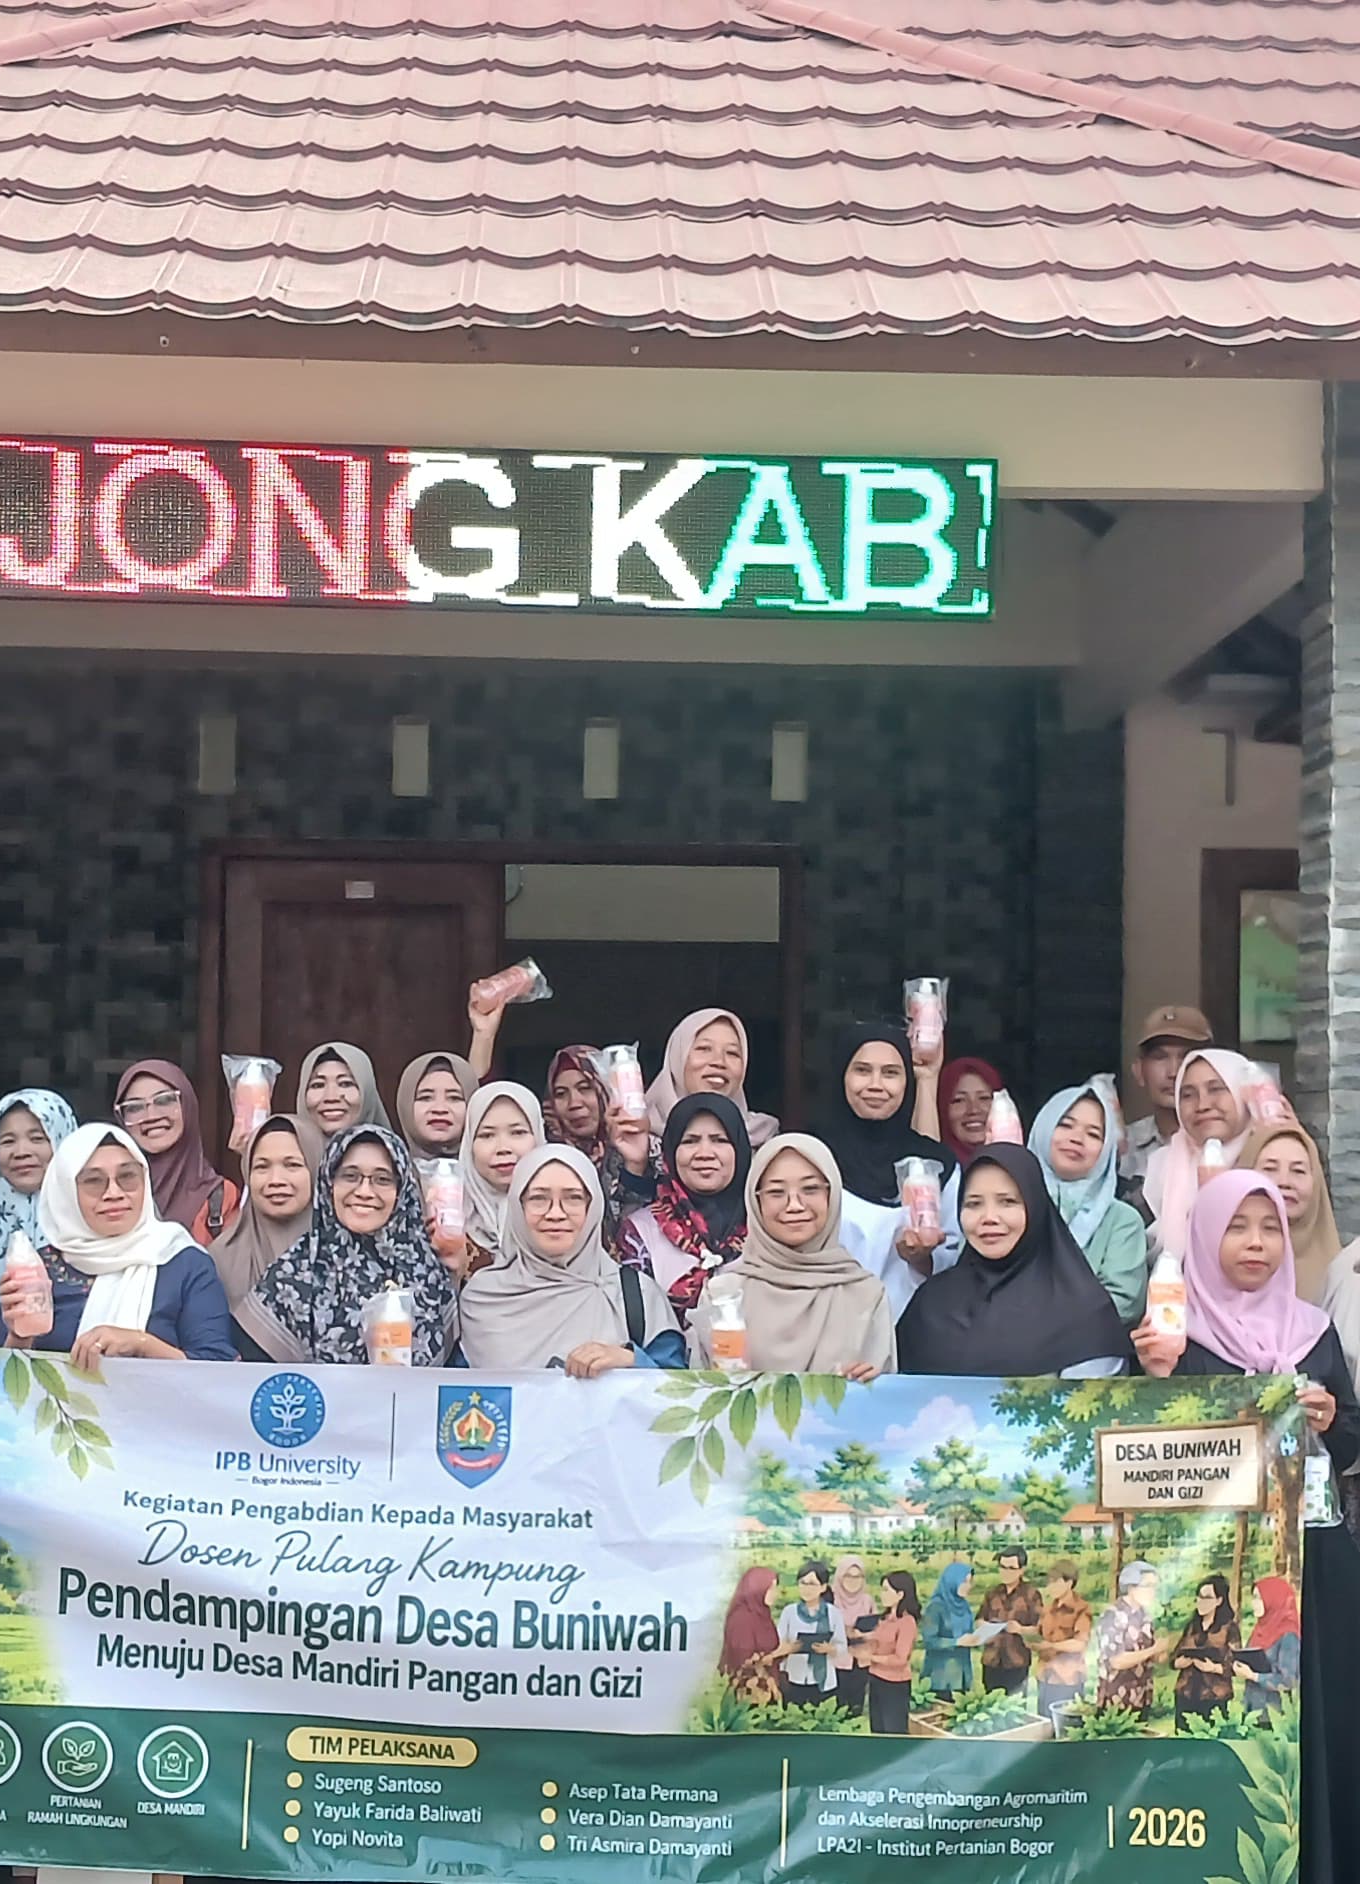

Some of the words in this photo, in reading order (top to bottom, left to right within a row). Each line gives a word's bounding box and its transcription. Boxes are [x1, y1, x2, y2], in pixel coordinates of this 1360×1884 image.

[589, 457, 959, 610] KAB
[1115, 1444, 1157, 1461] DESA
[1163, 1438, 1241, 1460] BUNIWAH
[215, 1451, 251, 1471] IPB
[258, 1453, 361, 1480] University
[1123, 1469, 1174, 1483] MANDIRI
[1177, 1466, 1230, 1481] PANGAN
[1147, 1486, 1174, 1500] DAN
[1177, 1485, 1203, 1499] GIZI
[123, 1490, 223, 1515] Kegiatan
[231, 1499, 364, 1525] Pengabdian
[371, 1503, 455, 1528] Kepada
[462, 1506, 593, 1533] Masyarakat
[138, 1519, 262, 1568] Dosen
[269, 1530, 402, 1597] Pulang
[408, 1535, 586, 1604] Kampung
[58, 1566, 382, 1651] Pendampingan
[396, 1594, 498, 1648] Desa
[513, 1599, 687, 1652] Buniwah
[96, 1633, 203, 1679] Menuju
[212, 1642, 283, 1678] Desa
[292, 1651, 399, 1689] Mandiri
[408, 1660, 518, 1702] Pangan
[526, 1664, 581, 1697] dan
[590, 1665, 643, 1698] Gizi
[309, 1735, 343, 1755] TIM
[348, 1737, 455, 1761] PELAKSANA
[314, 1773, 373, 1795] Sugeng
[377, 1775, 442, 1794] Santoso
[568, 1783, 608, 1802] Asep
[612, 1783, 646, 1800] Tata
[650, 1784, 718, 1803] Permana
[50, 1794, 102, 1810] PERTANIAN
[137, 1802, 162, 1815] DESA
[164, 1803, 205, 1816] MANDIRI
[818, 1787, 885, 1804] Lembaga
[888, 1788, 1001, 1809] Pengembangan
[1004, 1788, 1088, 1807] Agromaritim
[27, 1811, 63, 1825] RAMAH
[65, 1813, 128, 1829] LINGKUNGAN
[314, 1801, 361, 1823] Yayuk
[365, 1803, 415, 1821] Farida
[419, 1804, 482, 1823] Baliwati
[568, 1808, 604, 1826] Vera
[609, 1809, 645, 1827] Dian
[649, 1811, 733, 1832] Damayanti
[818, 1811, 845, 1827] dan
[849, 1812, 924, 1830] Akselerasi
[928, 1814, 1043, 1834] Innopreneurship
[312, 1828, 347, 1849] Yopi
[352, 1829, 404, 1848] Novita
[1128, 1807, 1207, 1849] 2026
[568, 1835, 587, 1852] Tri
[591, 1836, 644, 1854] Asmira
[649, 1838, 732, 1859] Damayanti
[876, 1839, 931, 1857] Institut
[935, 1840, 1006, 1857] Pertanian
[1010, 1839, 1055, 1857] Bogor
